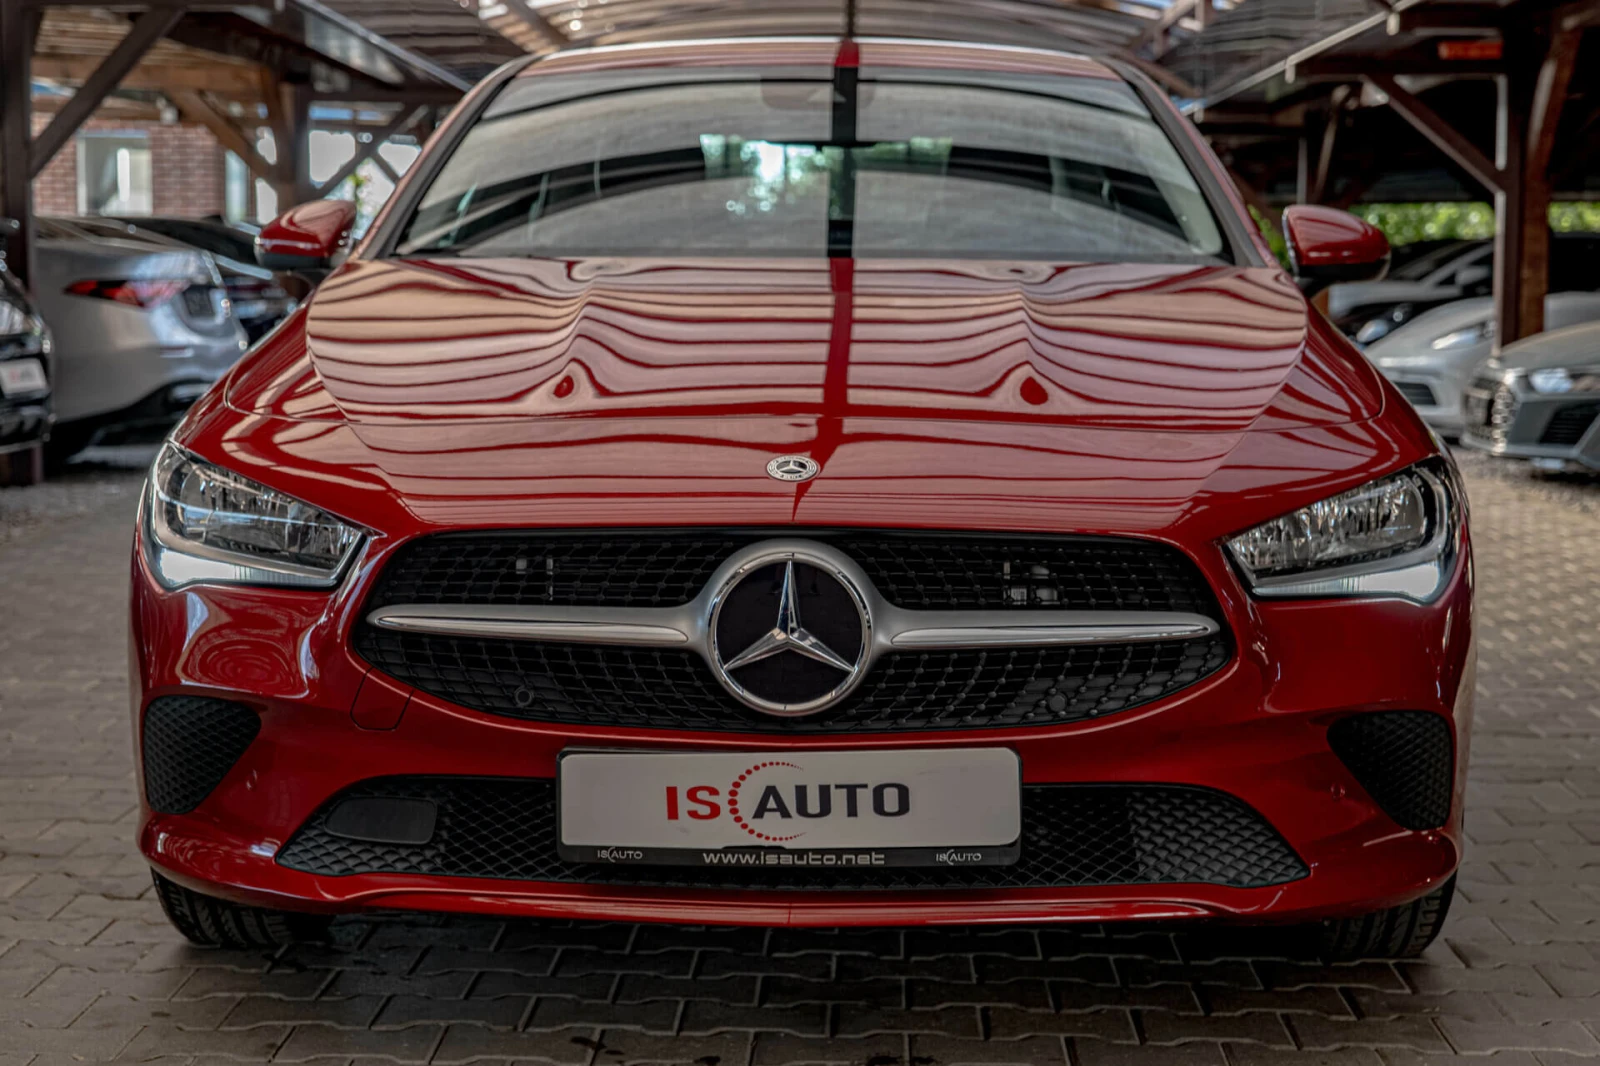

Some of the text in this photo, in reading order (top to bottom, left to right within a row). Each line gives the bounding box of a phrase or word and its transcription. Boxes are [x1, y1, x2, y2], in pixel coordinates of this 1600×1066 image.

[666, 782, 910, 820] IS AUTO
[703, 852, 885, 865] www.isauto.net
